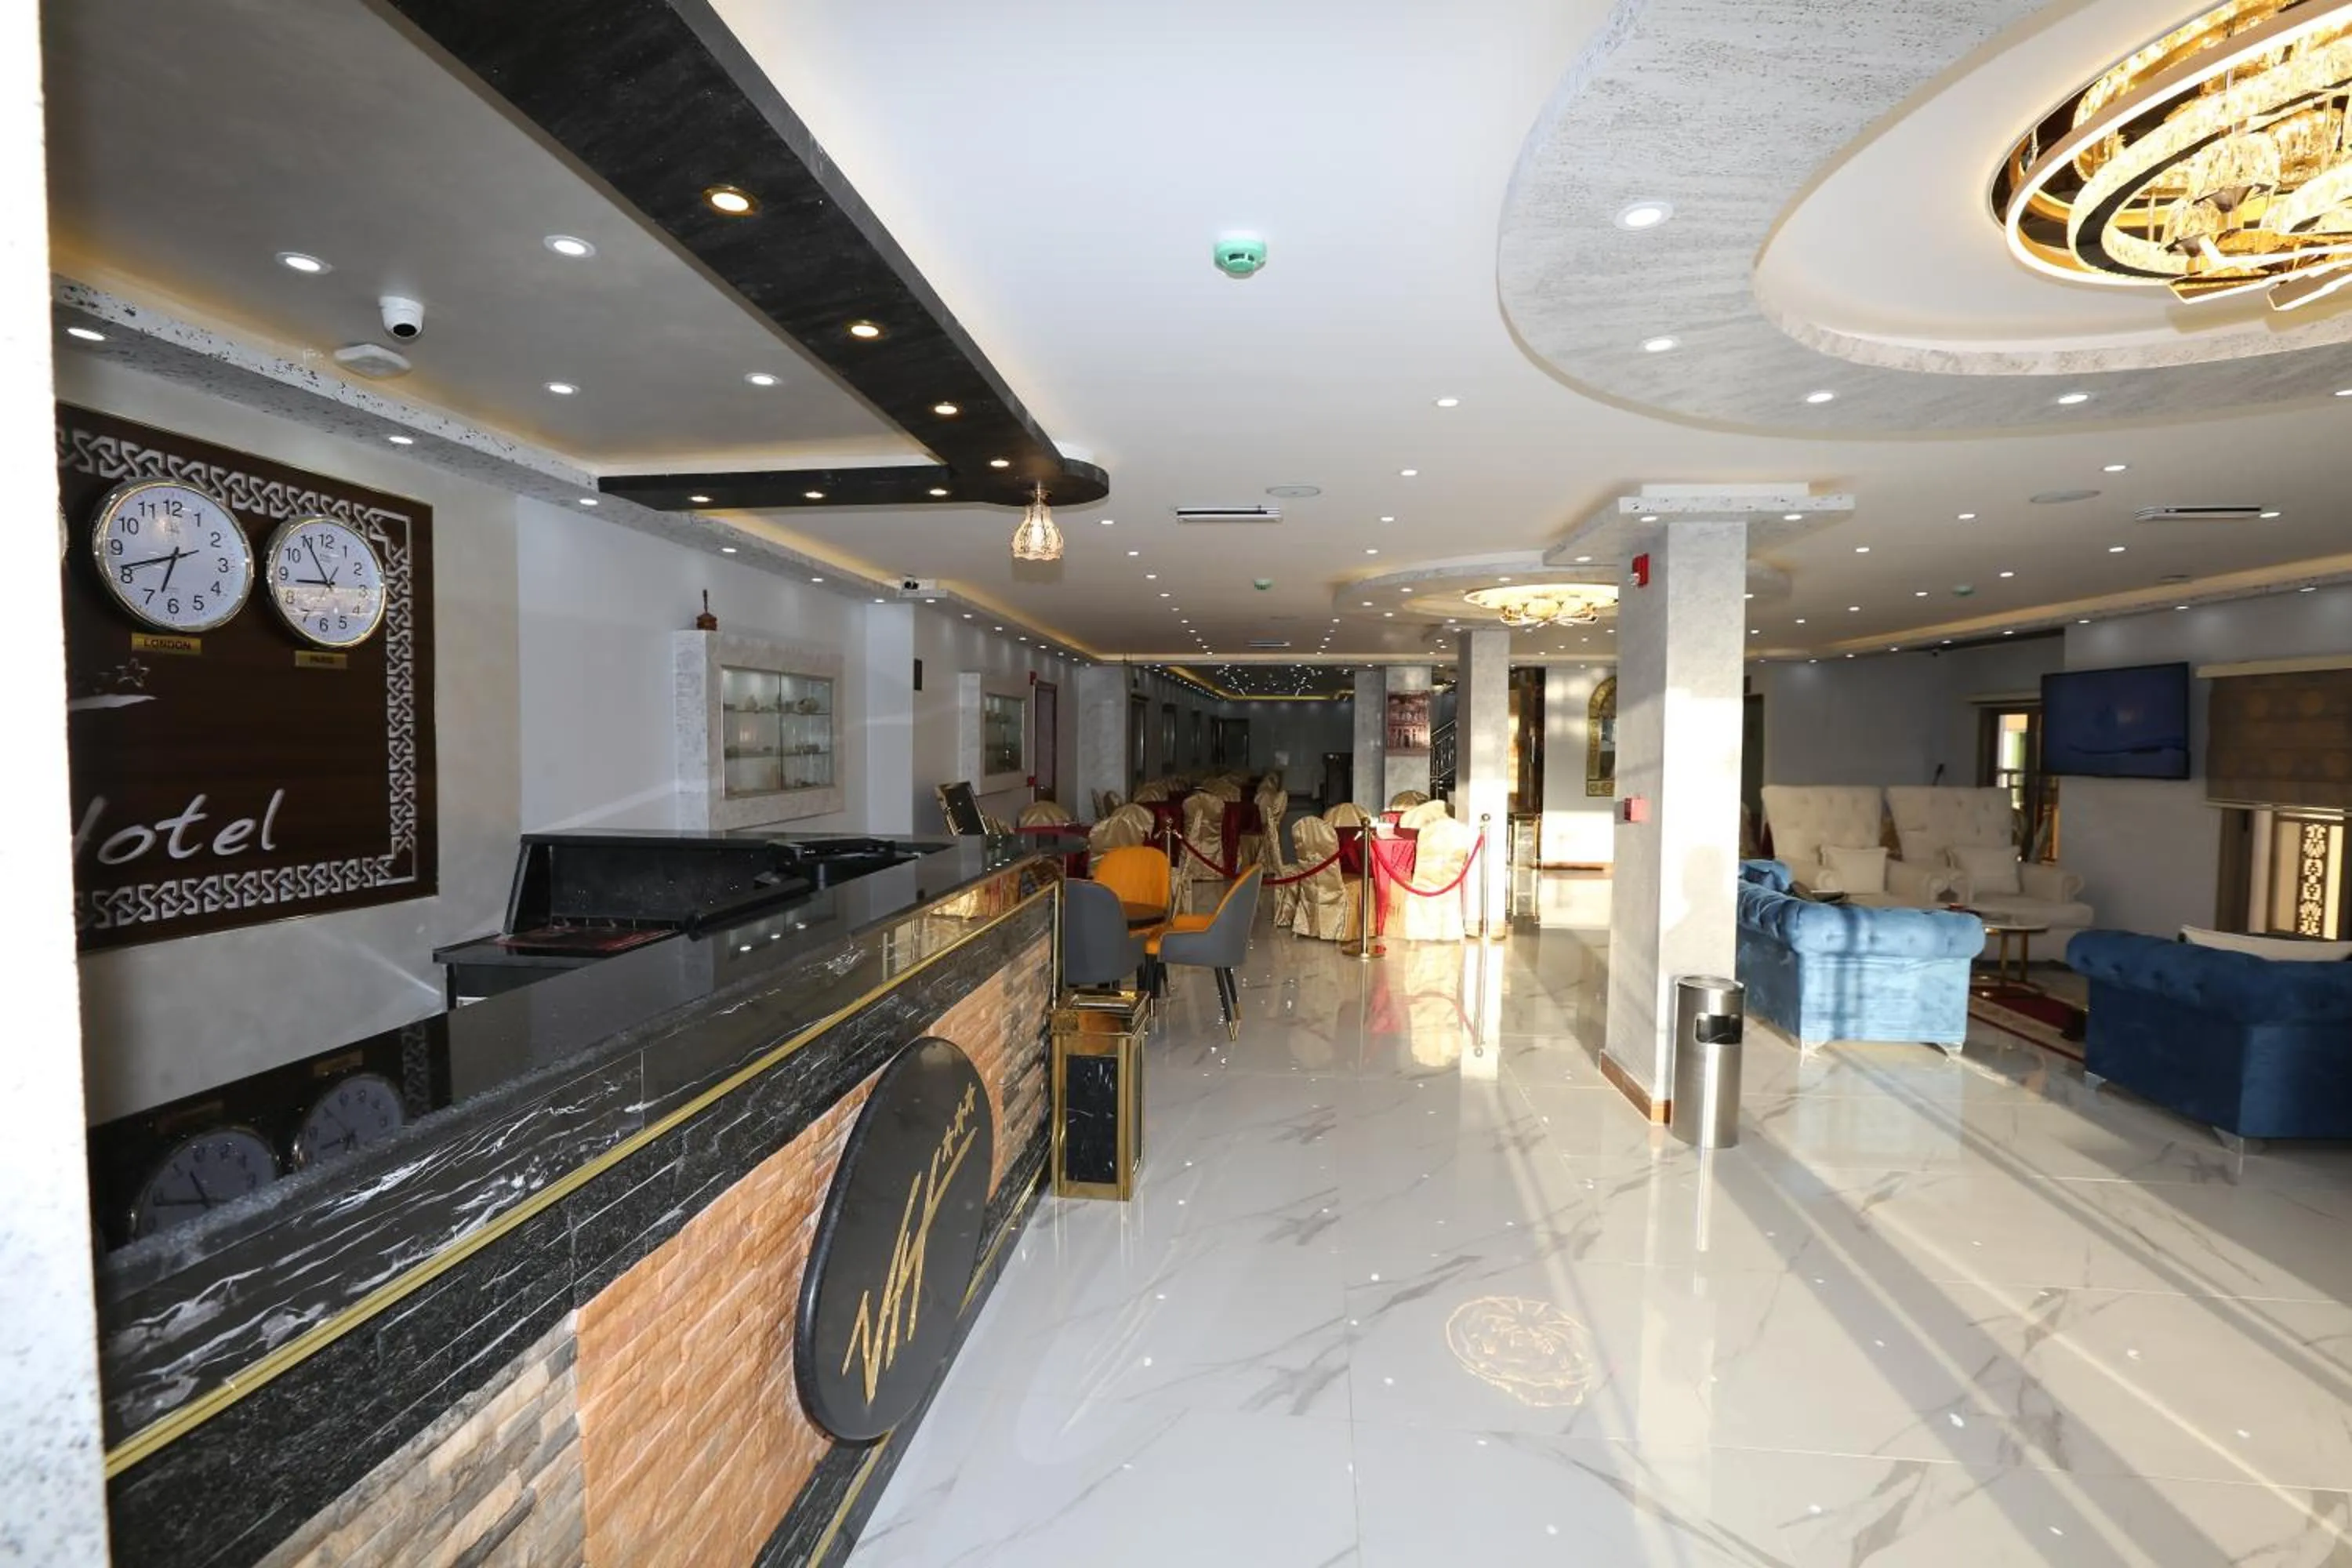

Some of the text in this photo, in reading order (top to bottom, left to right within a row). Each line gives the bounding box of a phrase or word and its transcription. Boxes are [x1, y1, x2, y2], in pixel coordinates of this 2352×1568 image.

[139, 501, 155, 519] 11
[163, 499, 183, 517] 12
[118, 517, 139, 535] 10
[194, 513, 201, 528] 1
[111, 539, 123, 555] 9
[210, 532, 221, 548] 2
[318, 534, 335, 550] 12
[285, 547, 301, 563] 10
[217, 557, 229, 573] 3
[278, 566, 289, 580] 9
[354, 561, 362, 575] 2
[121, 566, 133, 583] 8
[211, 581, 221, 596] 4
[143, 589, 155, 605] 7
[193, 595, 204, 611] 5
[285, 590, 295, 604] 8
[167, 598, 180, 614] 6
[319, 617, 328, 632] 6
[339, 615, 347, 629] 5
[144, 639, 191, 650] LONDON
